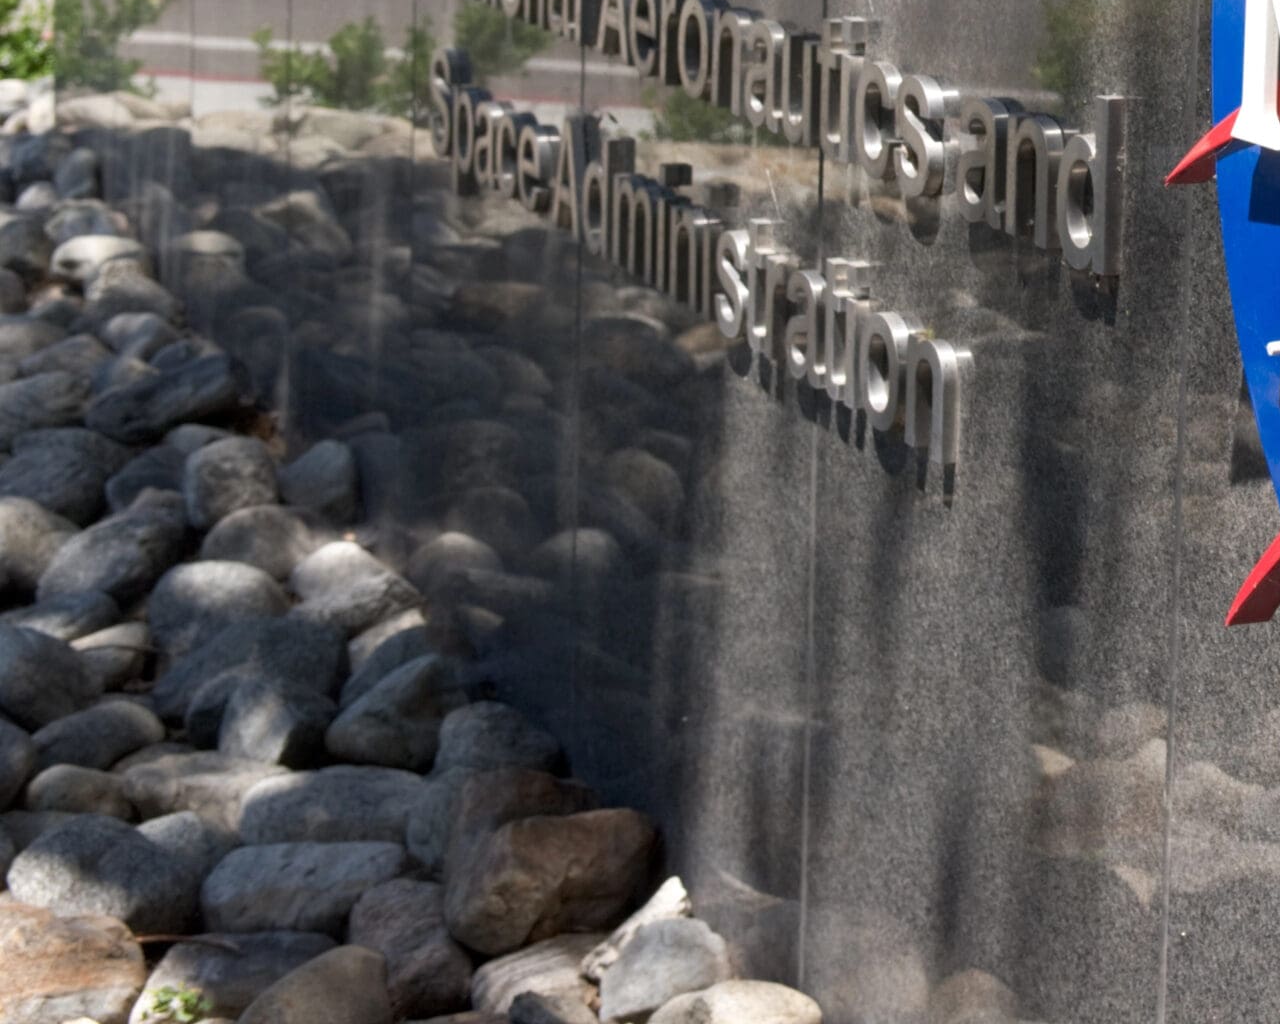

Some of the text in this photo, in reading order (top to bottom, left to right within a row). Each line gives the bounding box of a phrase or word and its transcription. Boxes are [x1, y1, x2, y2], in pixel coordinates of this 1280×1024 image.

[430, 47, 960, 464] Space Administration
[959, 94, 1125, 276] and
